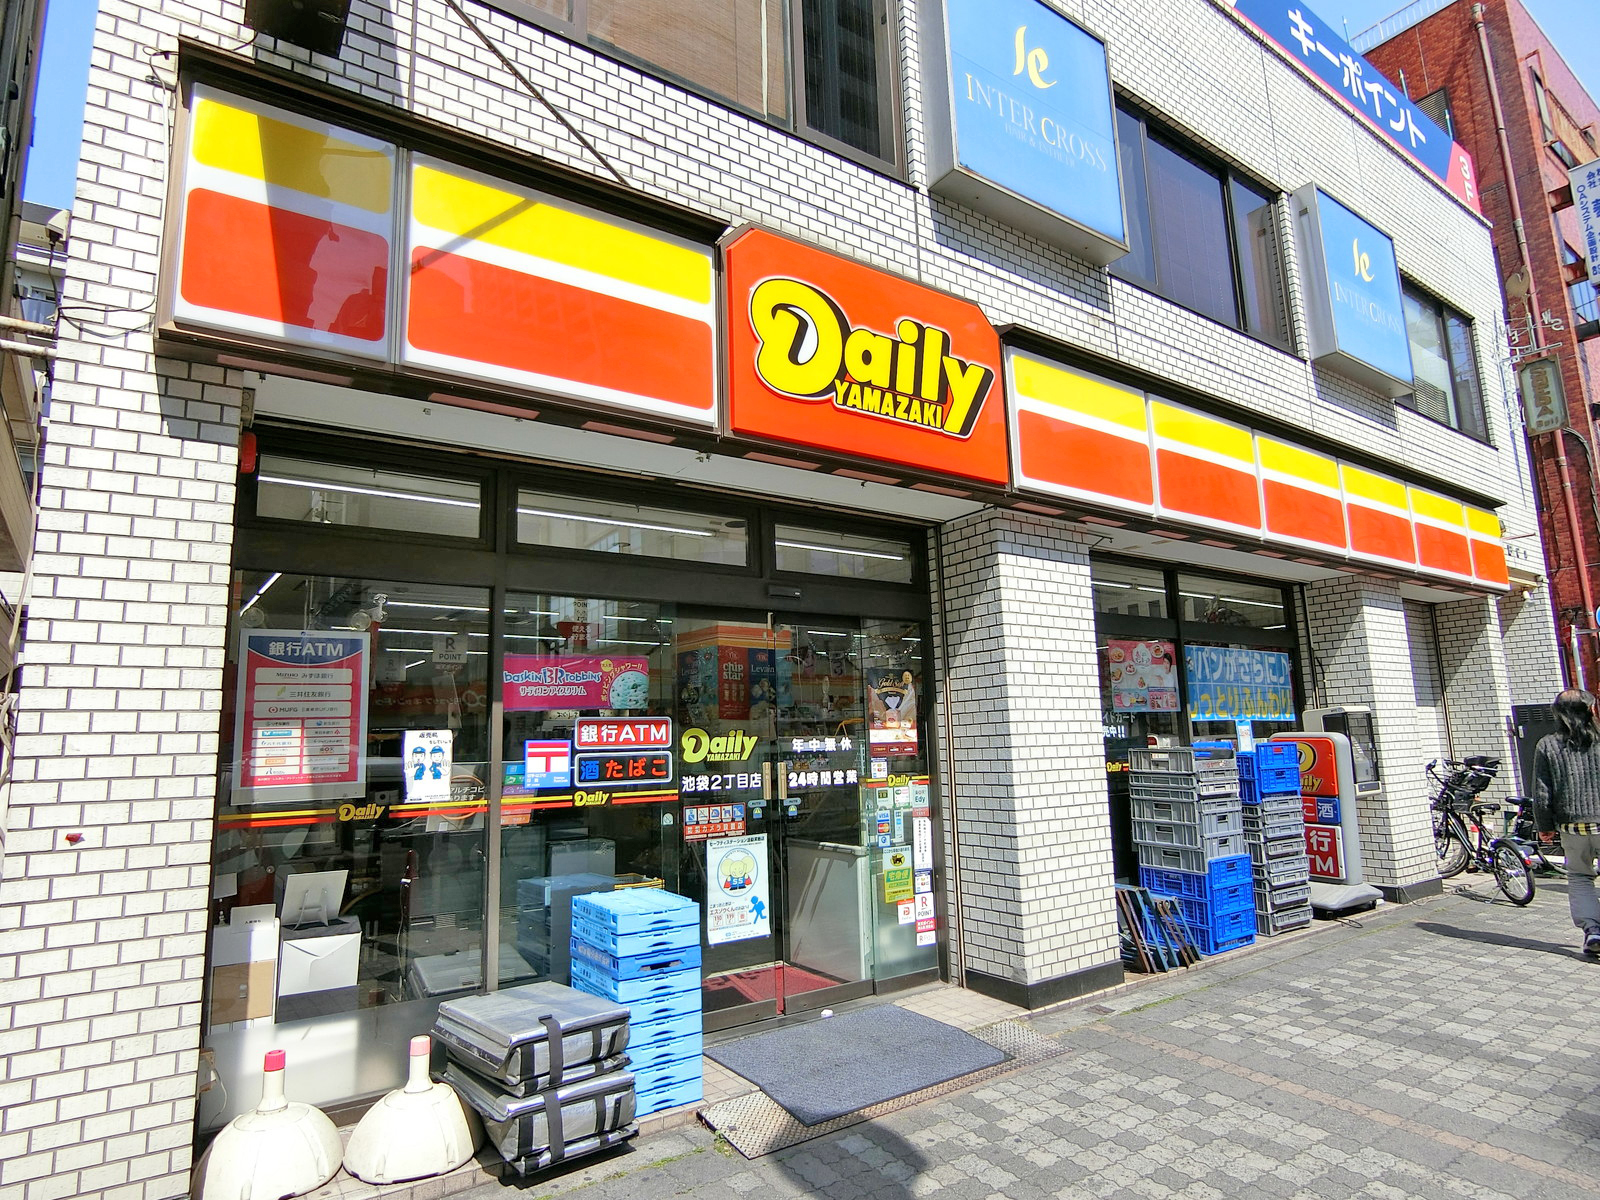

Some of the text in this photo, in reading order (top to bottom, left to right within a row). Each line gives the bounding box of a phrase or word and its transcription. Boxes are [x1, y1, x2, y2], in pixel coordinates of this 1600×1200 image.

[1287, 8, 1427, 148] キーポイント
[965, 72, 1108, 172] INTER CROSS
[750, 278, 994, 436] Daily
[834, 377, 944, 430] YAMAZAKI
[268, 641, 344, 657] 銀行ATM
[723, 661, 744, 672] chip
[751, 664, 775, 673] Levain
[1197, 651, 1277, 684] パンがさらに
[503, 671, 542, 683] baskin
[563, 671, 602, 683] robbins
[723, 671, 744, 680] star
[1190, 686, 1292, 719] しっとりふんわり
[580, 724, 667, 743] 銀行ATM
[682, 728, 758, 763] Daily
[792, 737, 852, 752] 年中無休
[706, 752, 741, 762] YAMAZAKI
[580, 757, 667, 779] 酒 たばこ
[682, 773, 762, 792] 池袋2丁目店
[789, 770, 858, 787] 24時間営業
[888, 775, 910, 787] Daily
[574, 791, 609, 806] Daily
[914, 795, 926, 803] Edy
[339, 803, 385, 821] Daily
[1318, 802, 1334, 818] 酒
[1309, 829, 1331, 852] 行
[918, 909, 932, 917] POINT
